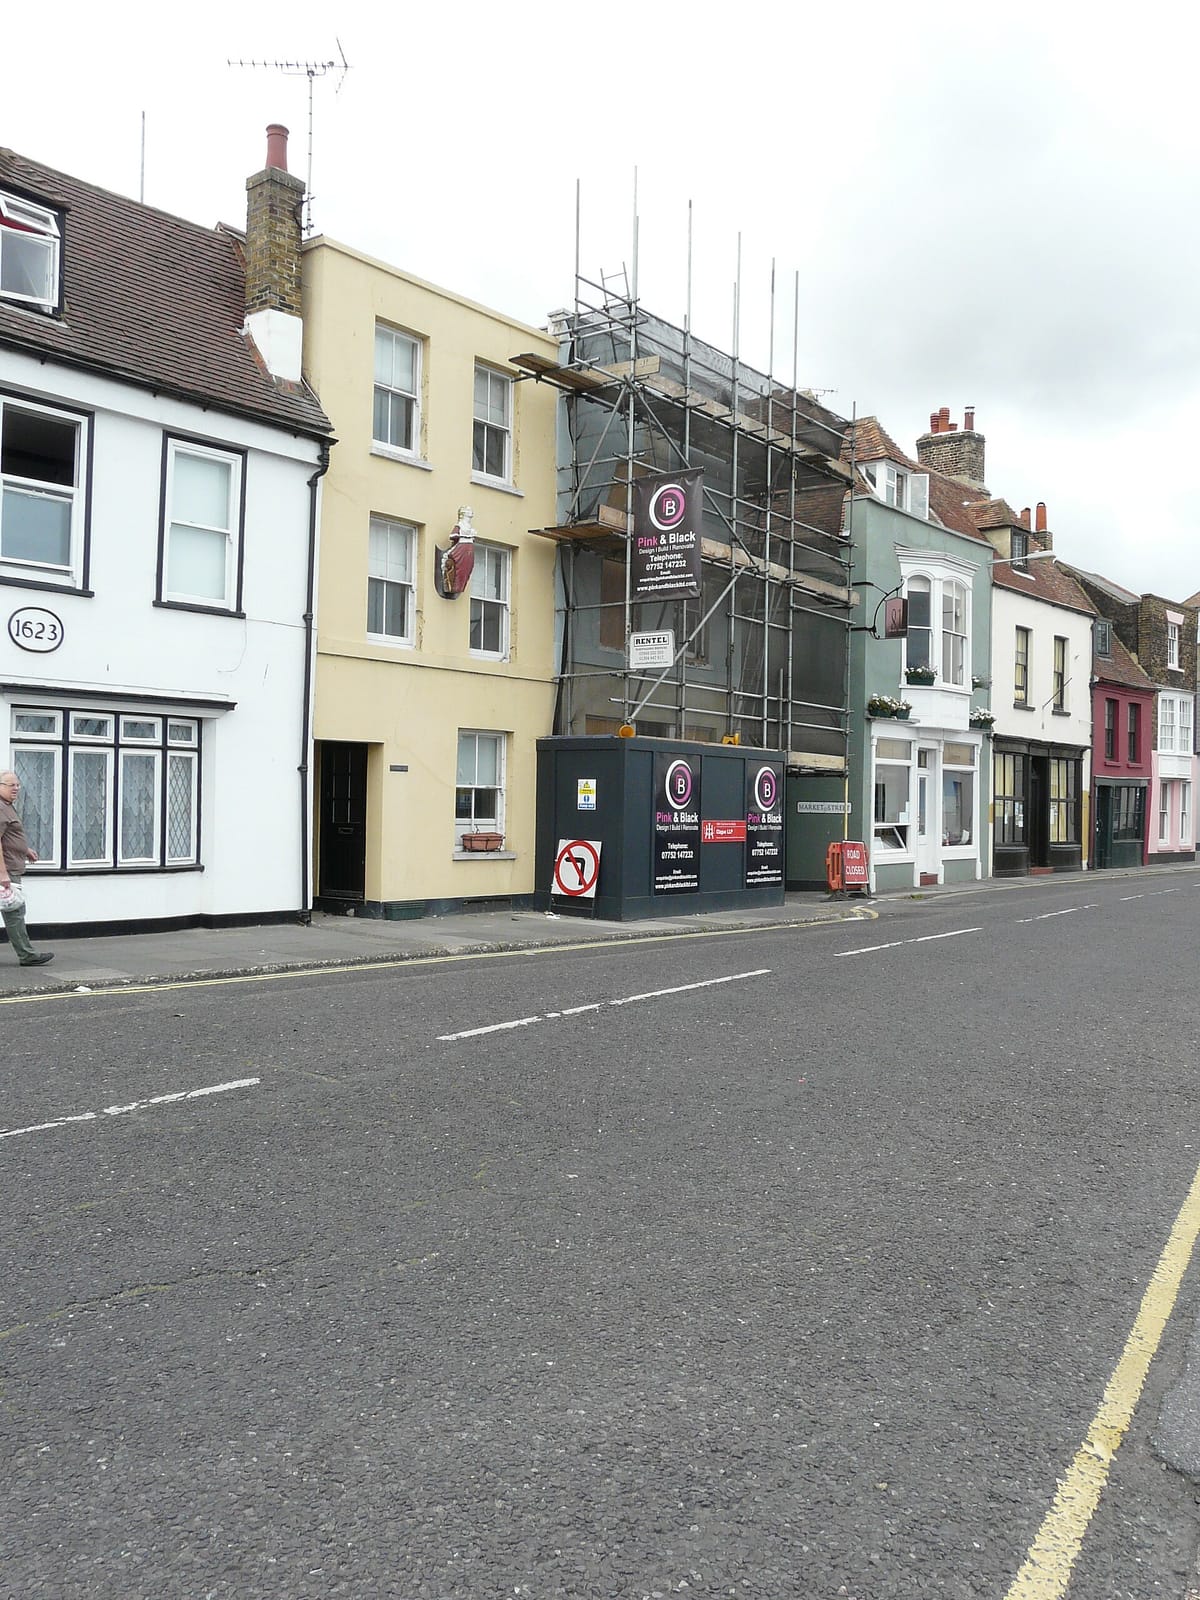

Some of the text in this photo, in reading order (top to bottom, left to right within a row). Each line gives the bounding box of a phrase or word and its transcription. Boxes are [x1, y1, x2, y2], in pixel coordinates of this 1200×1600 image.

[638, 531, 696, 548] Pink & Black
[650, 553, 683, 562] Telephone:
[664, 560, 687, 569] 147232
[15, 619, 58, 641] 1623
[635, 637, 667, 645] RENTEL
[656, 812, 699, 823] Pink & Black
[747, 813, 782, 823] Pink & Black
[847, 850, 860, 859] ROAD
[845, 866, 865, 875] CLOSED
